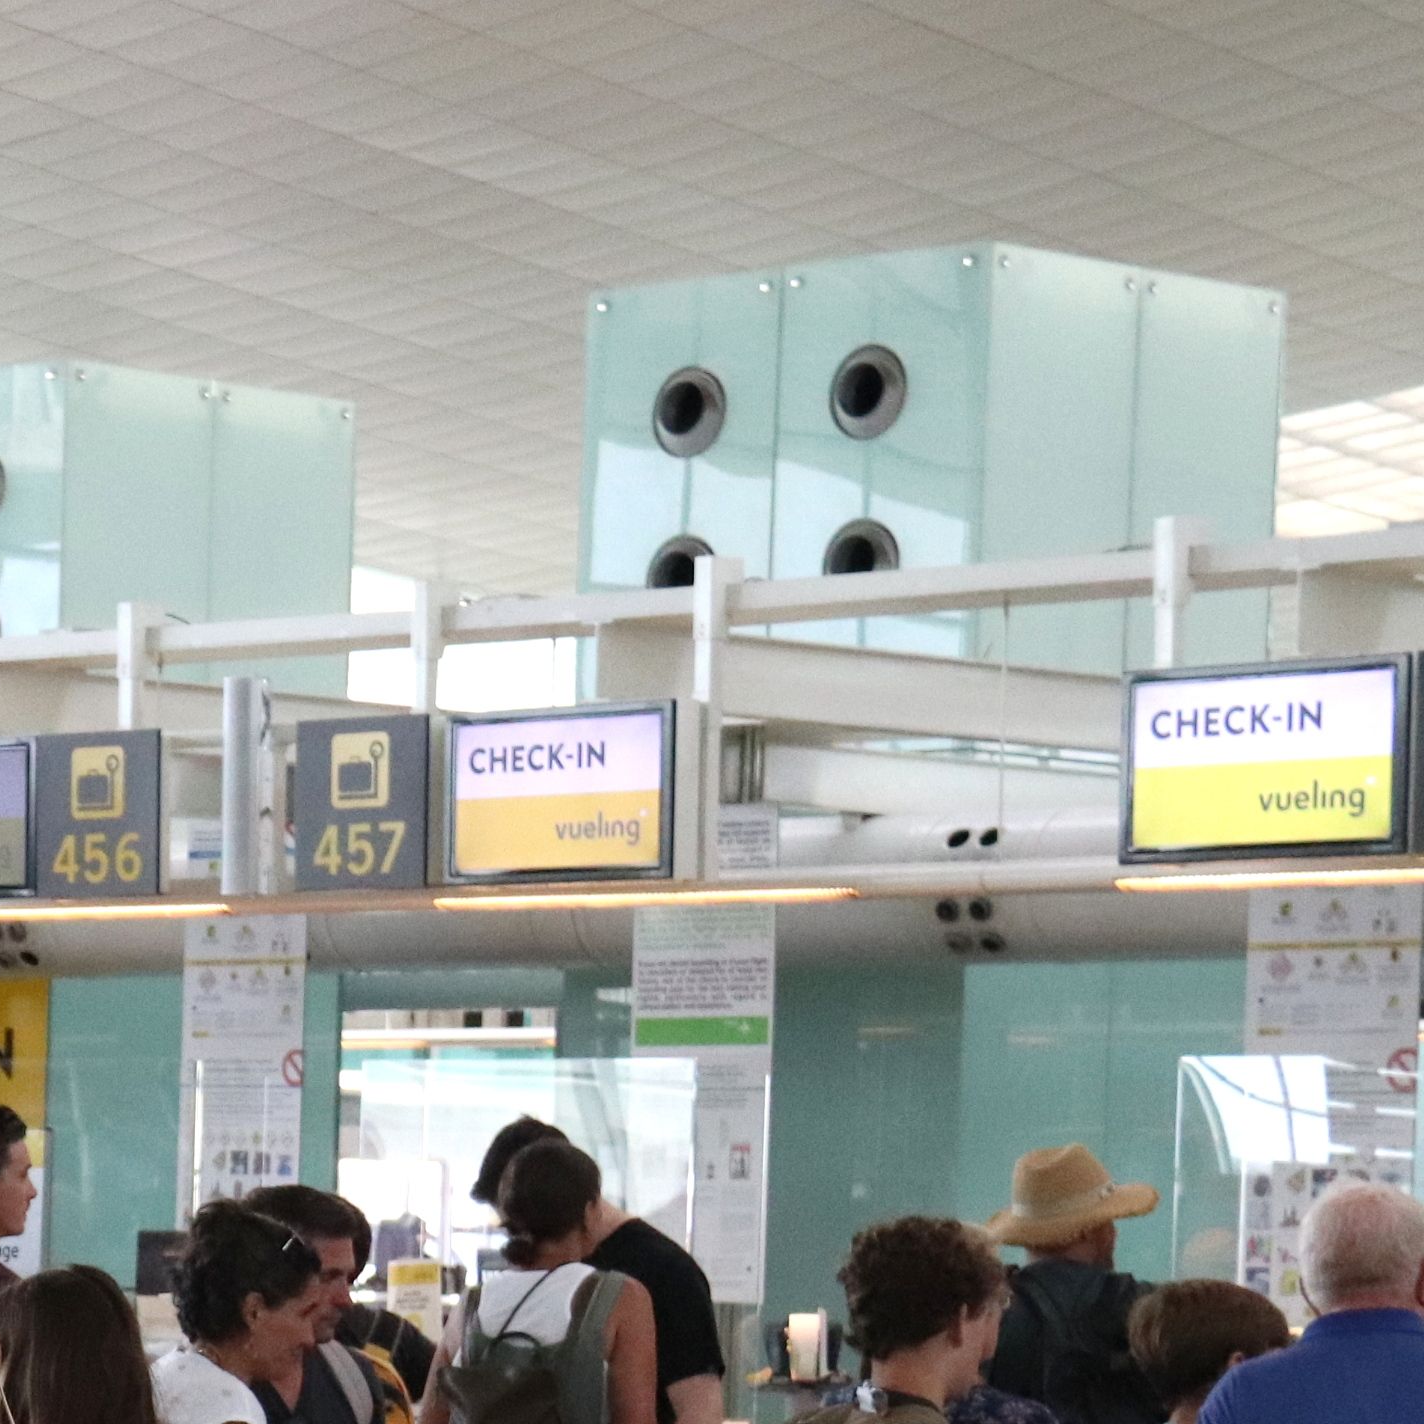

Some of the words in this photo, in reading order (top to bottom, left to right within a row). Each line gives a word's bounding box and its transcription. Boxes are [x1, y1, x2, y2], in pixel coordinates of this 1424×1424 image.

[1151, 701, 1322, 739] CHECK-IN
[469, 741, 606, 774] CHECK-IN
[1259, 780, 1365, 817] vueling
[555, 812, 640, 845] vueling
[53, 833, 142, 884] 456
[314, 821, 405, 876] 457
